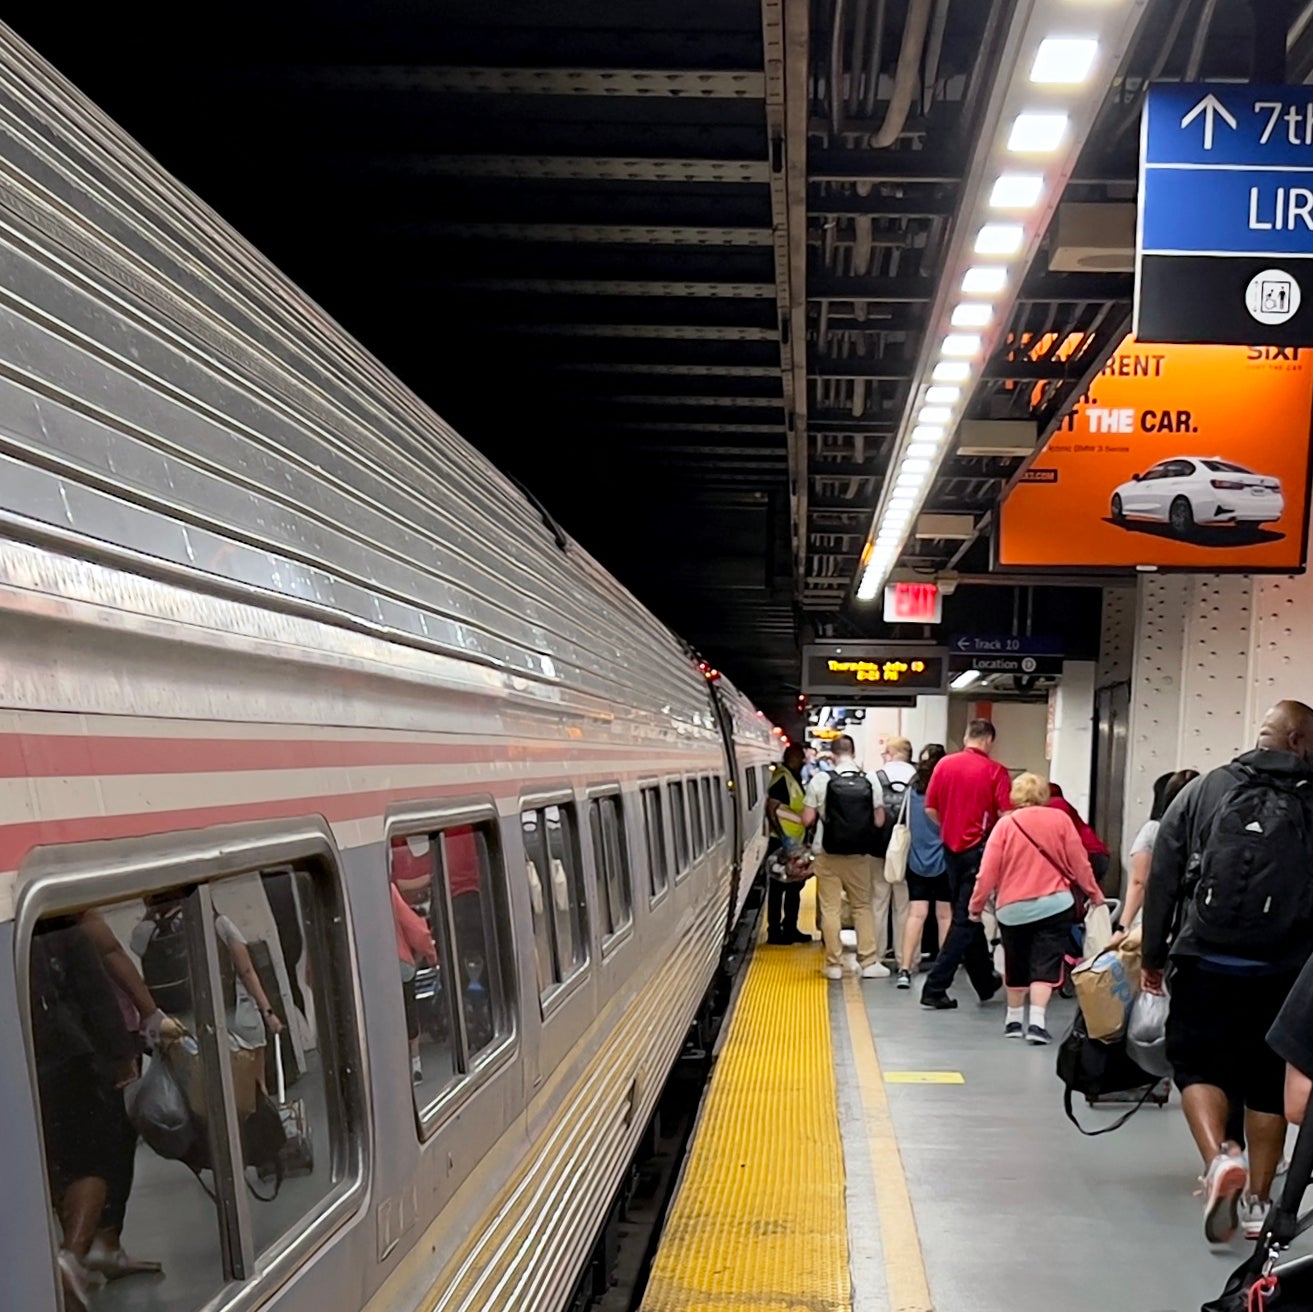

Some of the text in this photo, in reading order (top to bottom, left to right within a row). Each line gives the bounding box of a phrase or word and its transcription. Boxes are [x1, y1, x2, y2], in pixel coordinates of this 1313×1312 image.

[1085, 408, 1135, 433] THE
[1140, 410, 1198, 433] CAR.
[974, 639, 1020, 650] Track 10
[972, 658, 1018, 669] Location
